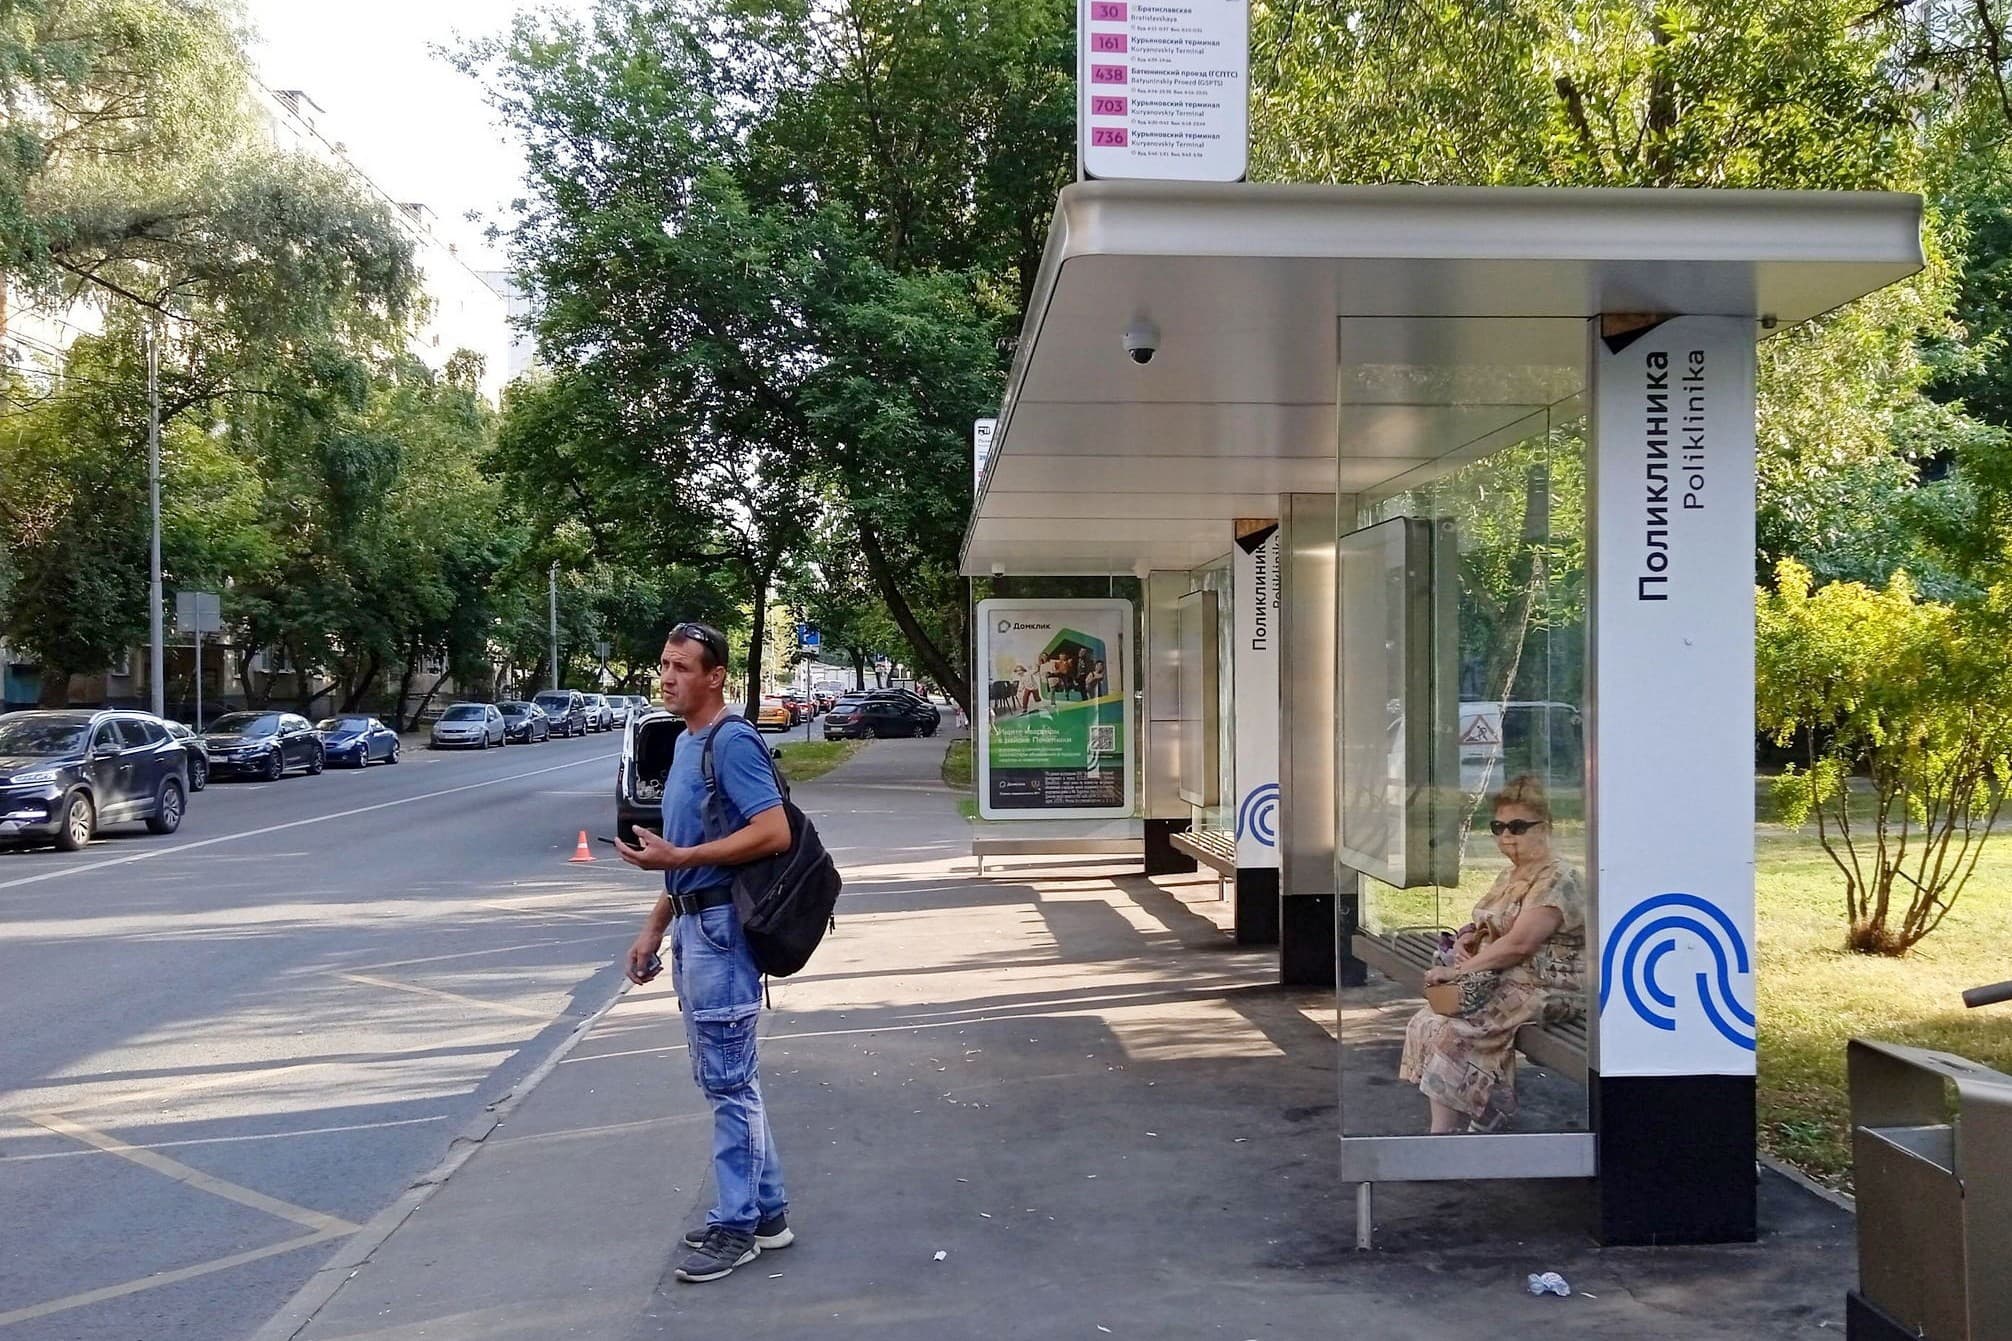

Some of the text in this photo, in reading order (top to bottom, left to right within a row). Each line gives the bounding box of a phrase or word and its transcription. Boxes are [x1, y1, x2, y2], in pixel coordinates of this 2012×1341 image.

[1101, 5, 1119, 18] 30
[1137, 5, 1192, 14] Братиславская
[1099, 37, 1119, 50] 161
[1131, 36, 1183, 46] Курьяновский
[1095, 68, 1123, 81] 438
[1208, 70, 1238, 78] (ГСПТС)
[1095, 100, 1123, 112] 703
[1131, 99, 1183, 108] Курьяновский
[1095, 131, 1124, 144] 736
[1131, 130, 1183, 140] Курьяновский
[1682, 350, 1704, 509] Poliklinika
[1638, 351, 1668, 601] Поликлиника
[1252, 542, 1266, 650] Поликлиник
